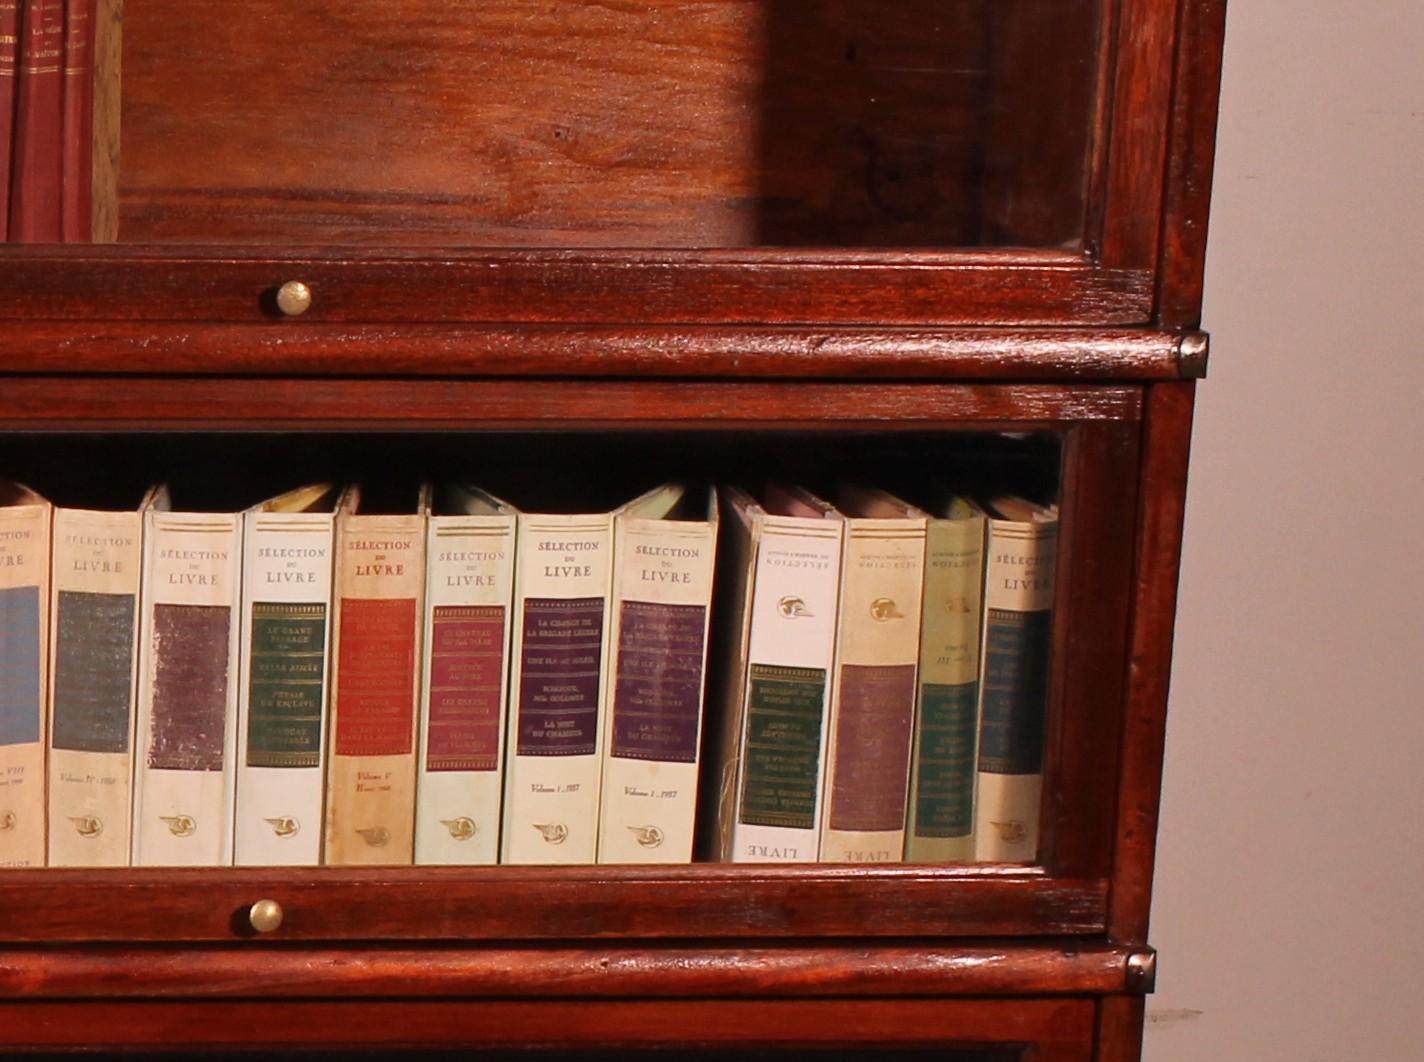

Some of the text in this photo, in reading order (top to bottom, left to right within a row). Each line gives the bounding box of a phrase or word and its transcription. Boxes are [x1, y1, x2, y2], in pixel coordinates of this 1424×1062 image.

[348, 540, 412, 551] SÉLECTION
[537, 540, 600, 552] SÉLECTION
[634, 544, 700, 559] SÉLECTION
[159, 548, 229, 562] SÉLECTION
[257, 547, 326, 559] SÉLECTION
[438, 551, 506, 562] SÉLECTION
[72, 560, 123, 574] LIVRE
[355, 564, 405, 577] LIVRE
[544, 566, 592, 578] LIVRE
[168, 572, 219, 587] LIVRE
[266, 571, 317, 584] LIVRE
[446, 575, 497, 587] LIVRE
[641, 569, 692, 584] LIVRE
[746, 845, 799, 859] LIVRE
